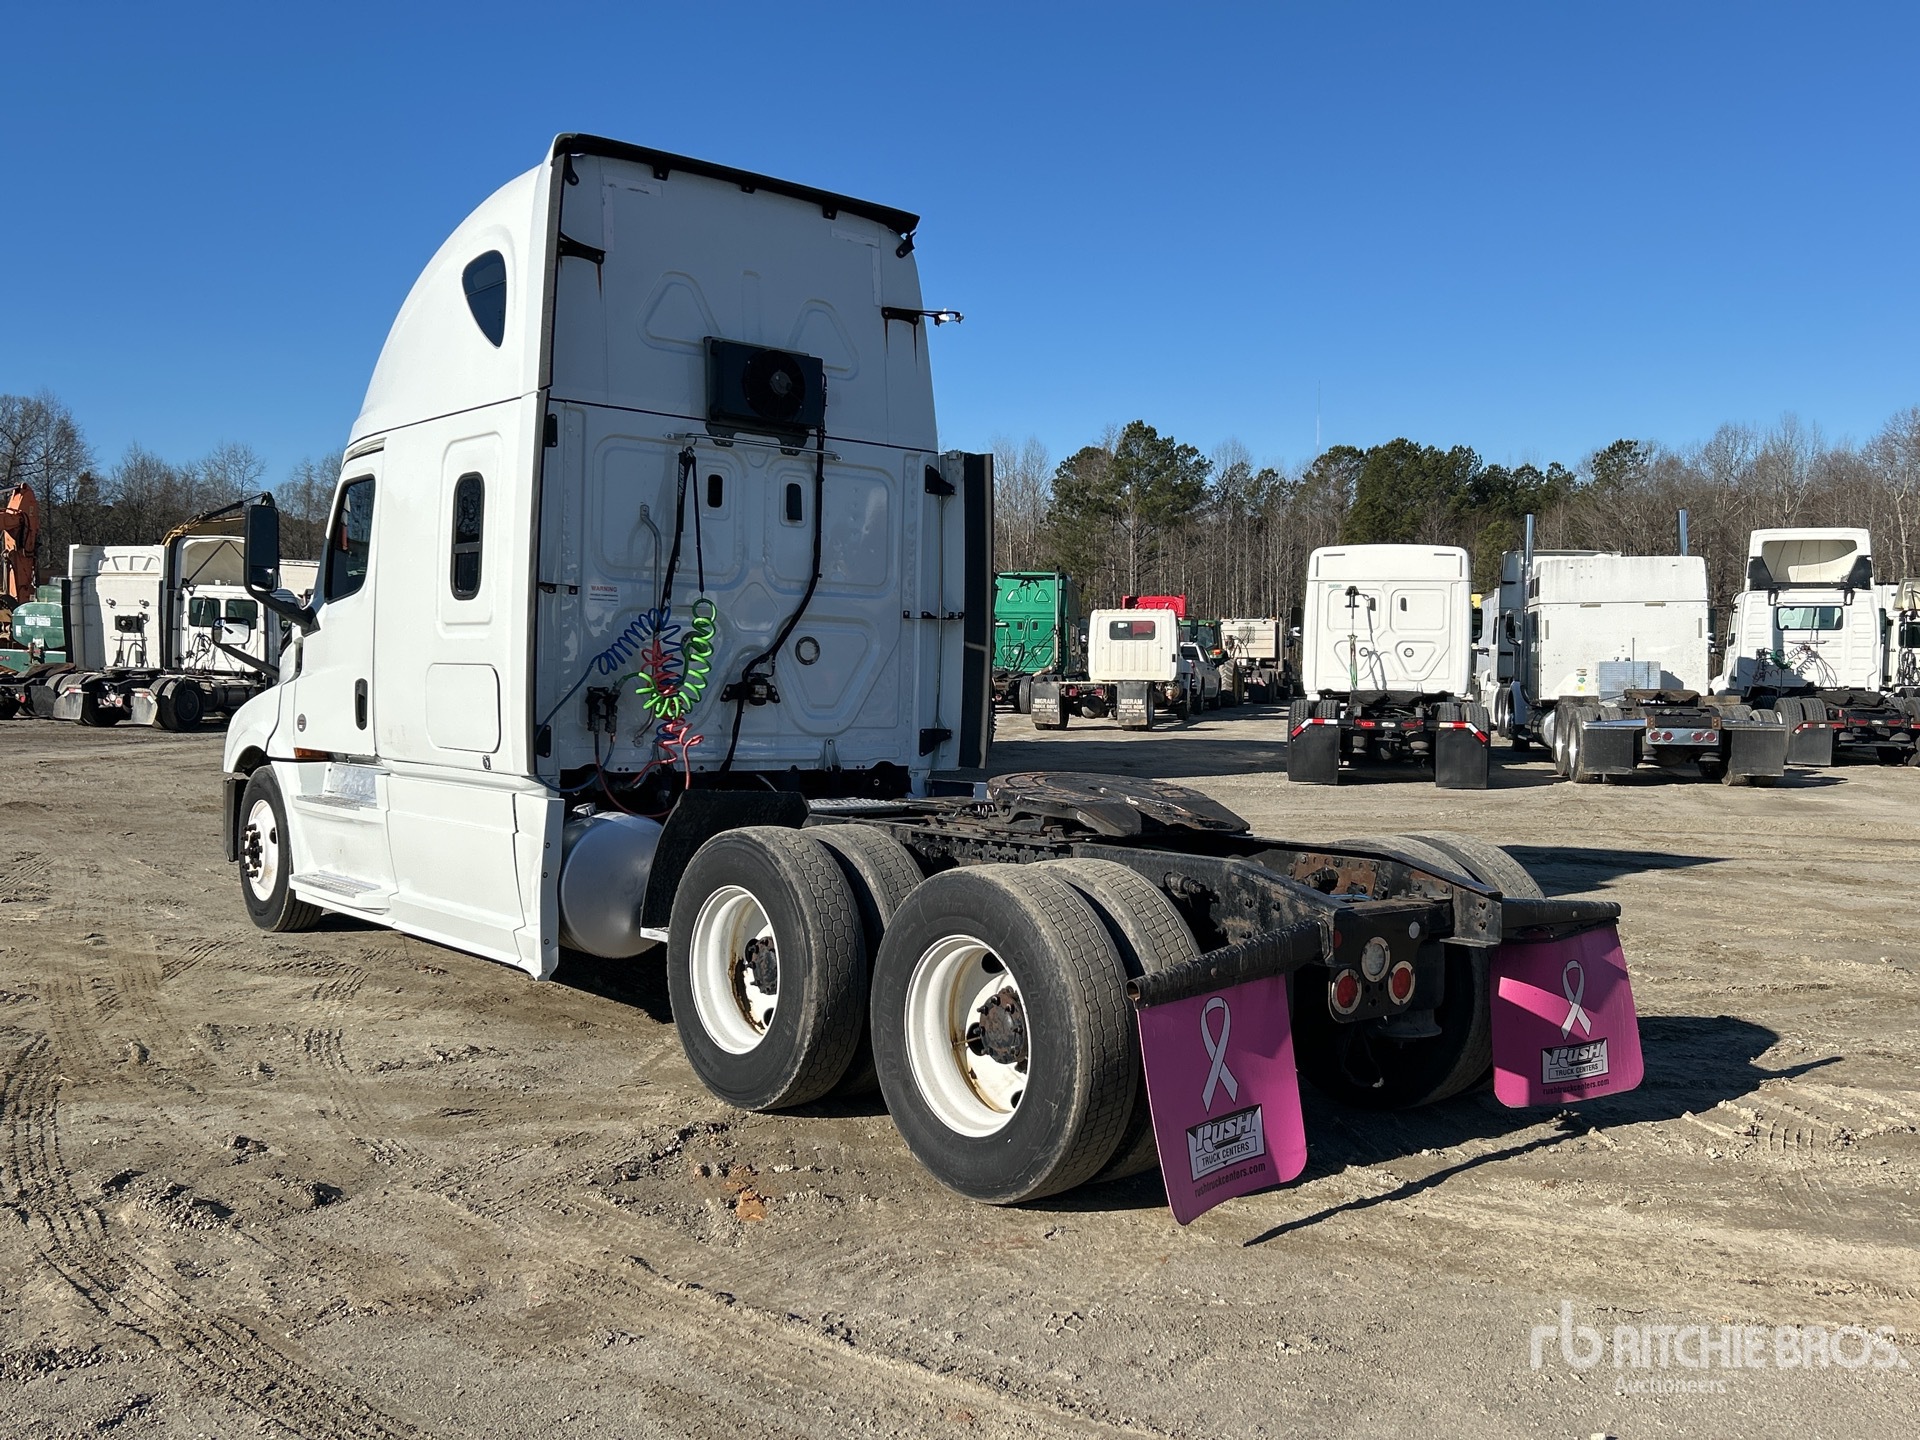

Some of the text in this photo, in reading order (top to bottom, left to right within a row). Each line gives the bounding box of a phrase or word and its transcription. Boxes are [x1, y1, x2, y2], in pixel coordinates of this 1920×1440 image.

[1550, 1042, 1602, 1069] RUSH
[1555, 1063, 1599, 1077] TRUCK CENTERS
[1543, 1079, 1610, 1095] rushtruckcenters.com
[1196, 1112, 1254, 1153] RUSH
[1201, 1141, 1250, 1167] TRUCK CENTERS
[1194, 1162, 1267, 1198] rushtruckcenters.com
